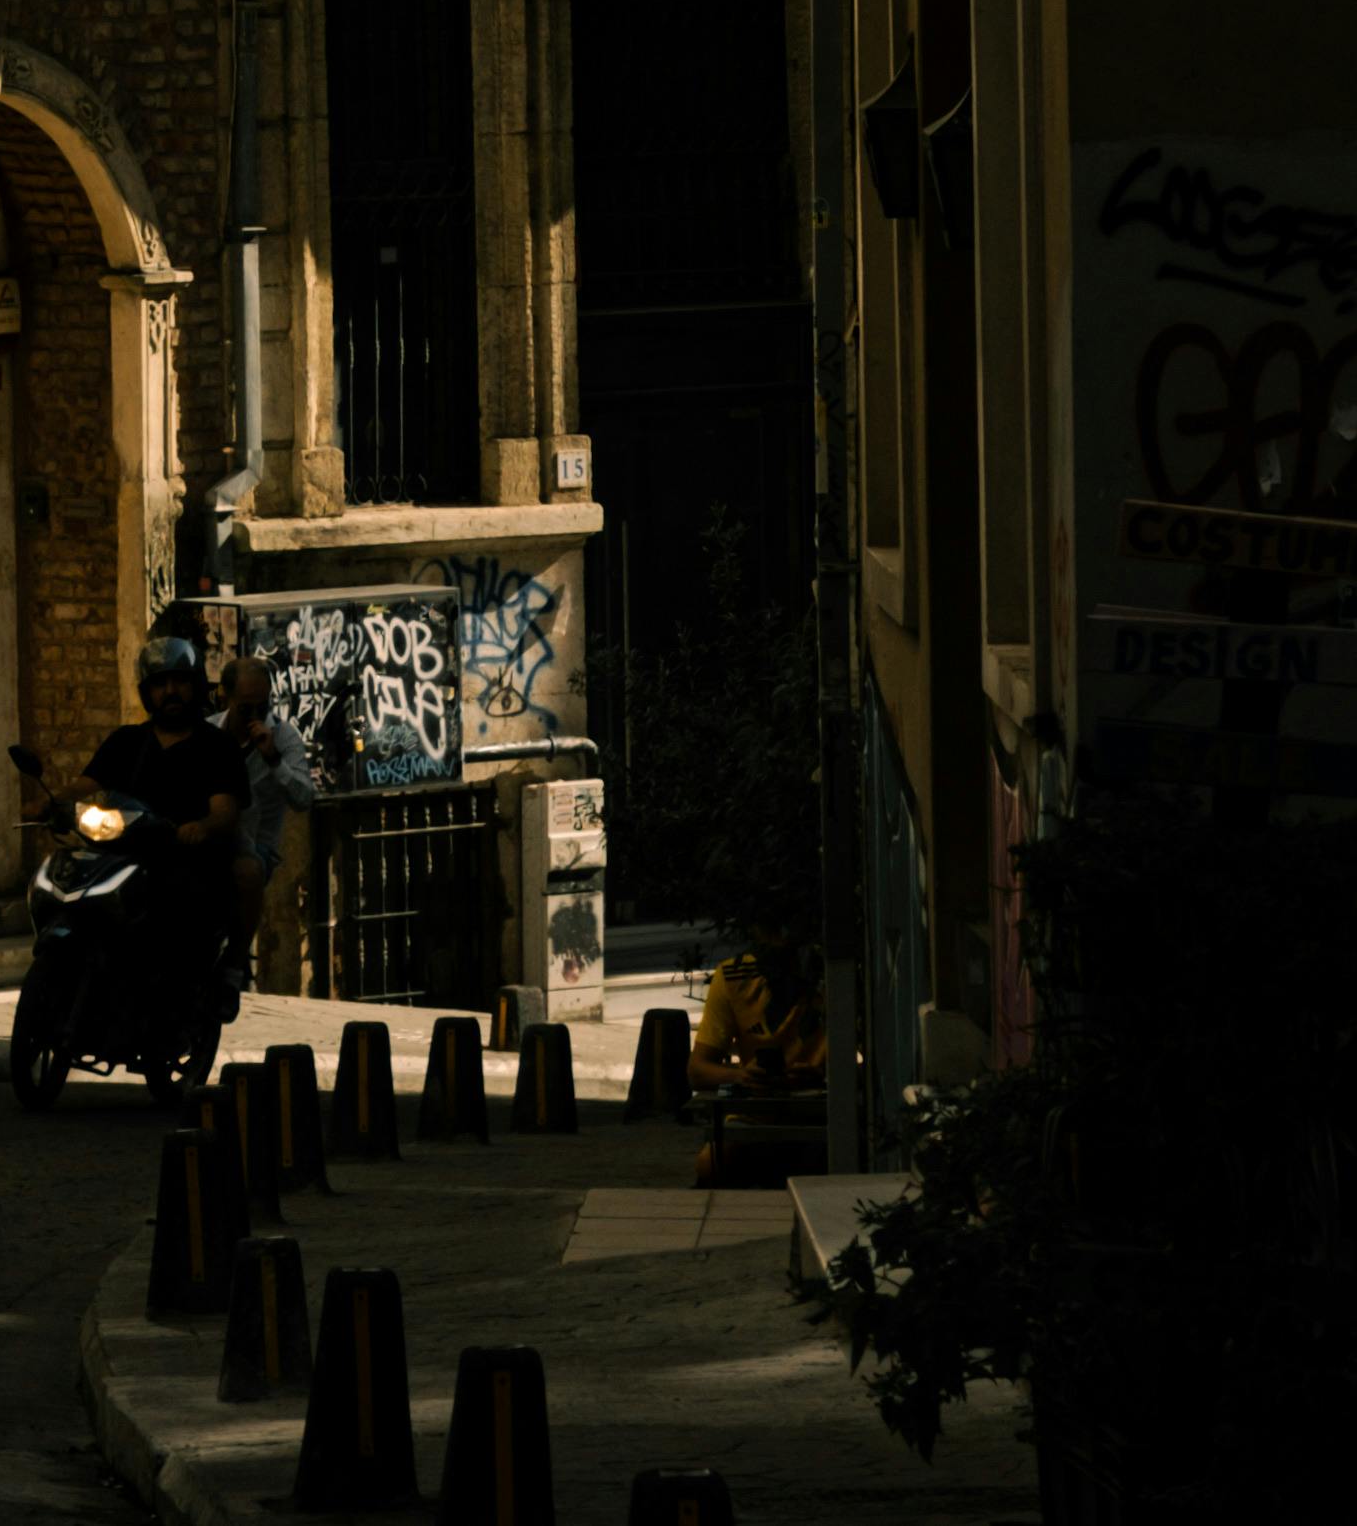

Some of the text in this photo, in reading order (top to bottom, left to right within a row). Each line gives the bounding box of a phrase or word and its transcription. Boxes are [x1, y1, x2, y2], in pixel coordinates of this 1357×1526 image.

[561, 458, 584, 479] 15
[1125, 506, 1357, 575] COSTUM
[1113, 625, 1320, 684] DESIGN
